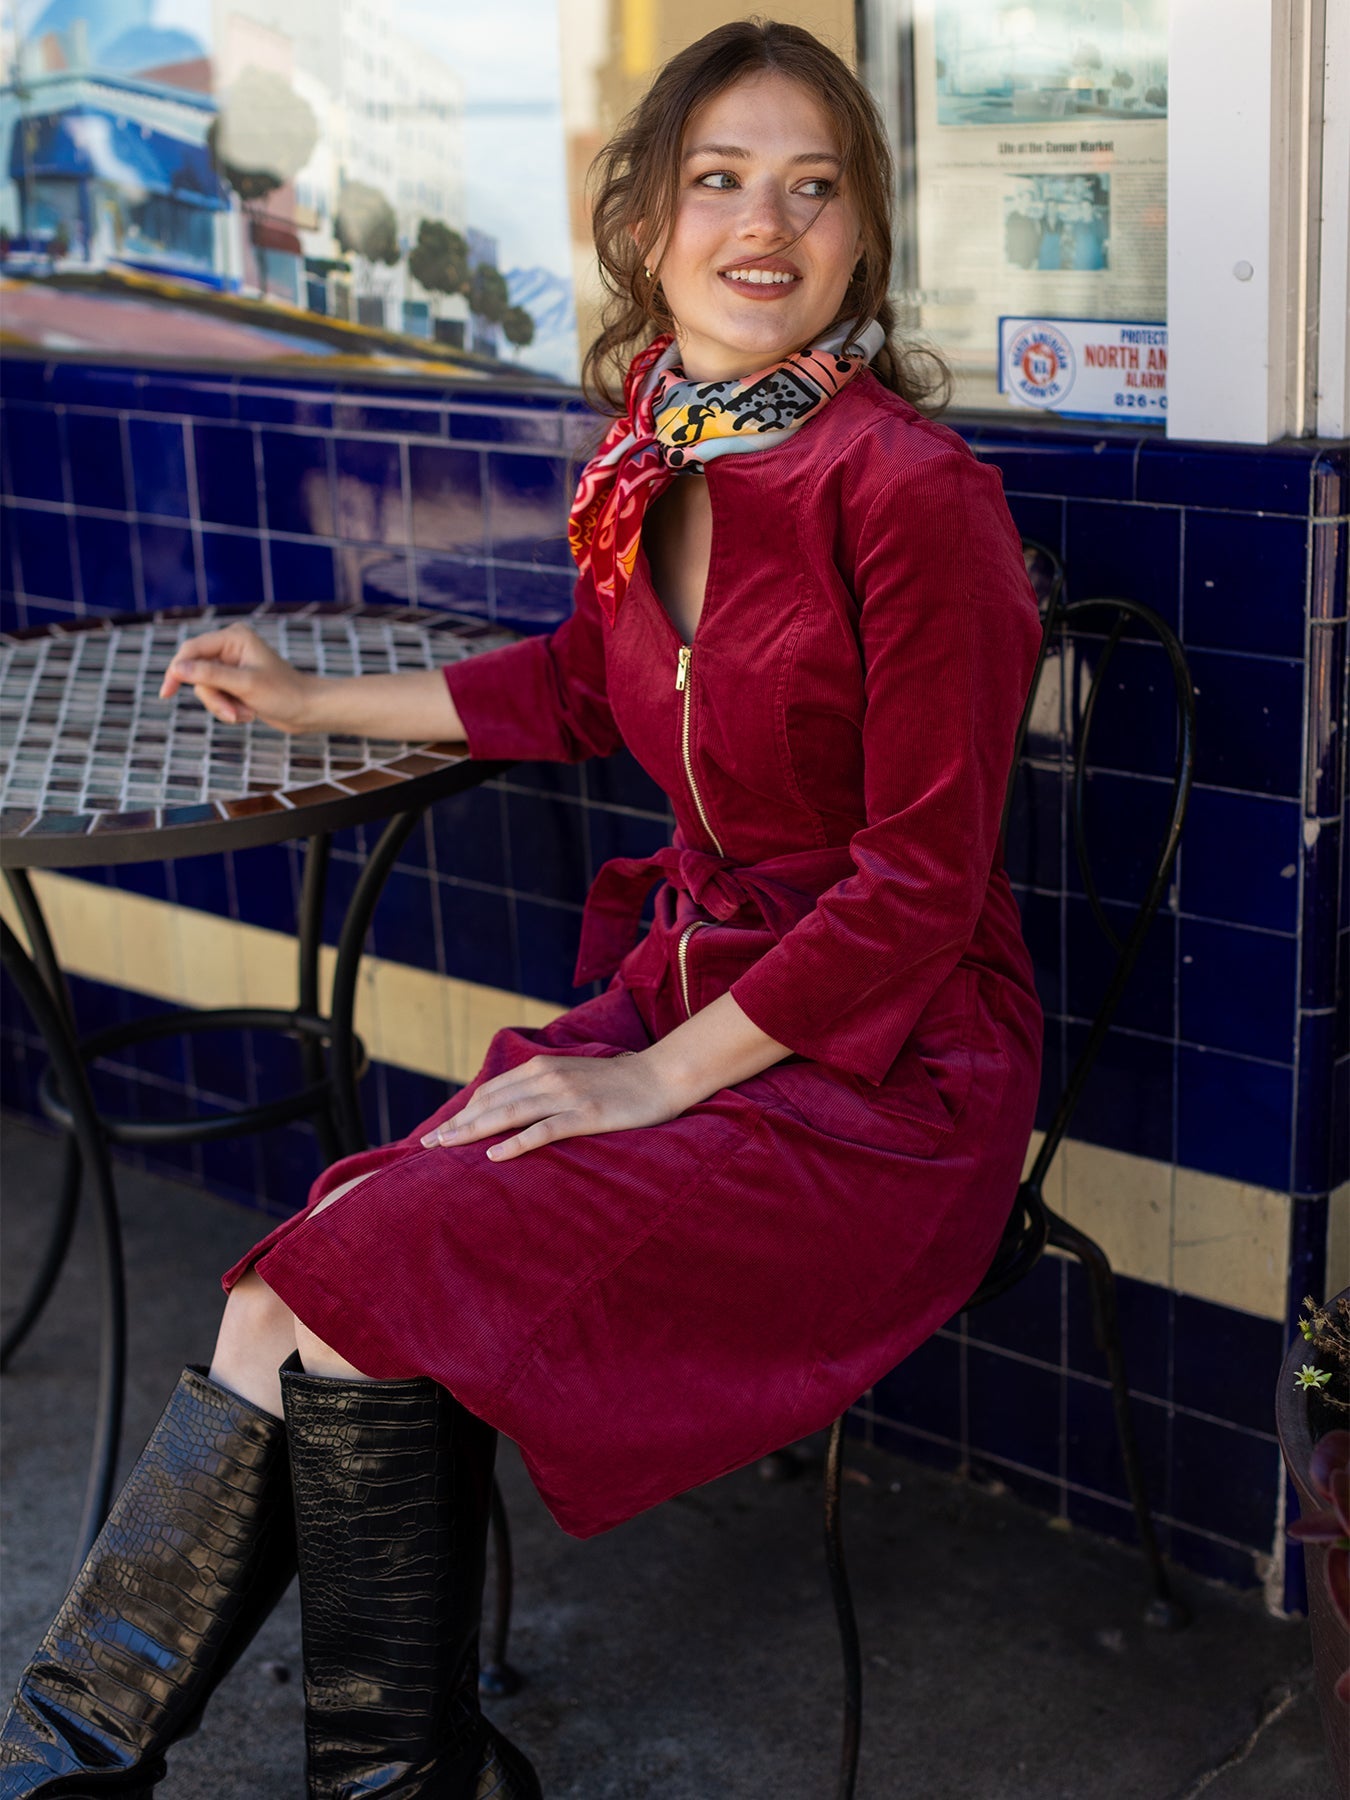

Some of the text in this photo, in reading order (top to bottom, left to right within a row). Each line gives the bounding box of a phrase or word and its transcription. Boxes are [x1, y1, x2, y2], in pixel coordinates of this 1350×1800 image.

[1029, 141, 1042, 153] the
[1045, 140, 1077, 153] Corner
[1080, 140, 1114, 152] Market
[1084, 344, 1139, 369] NORTH
